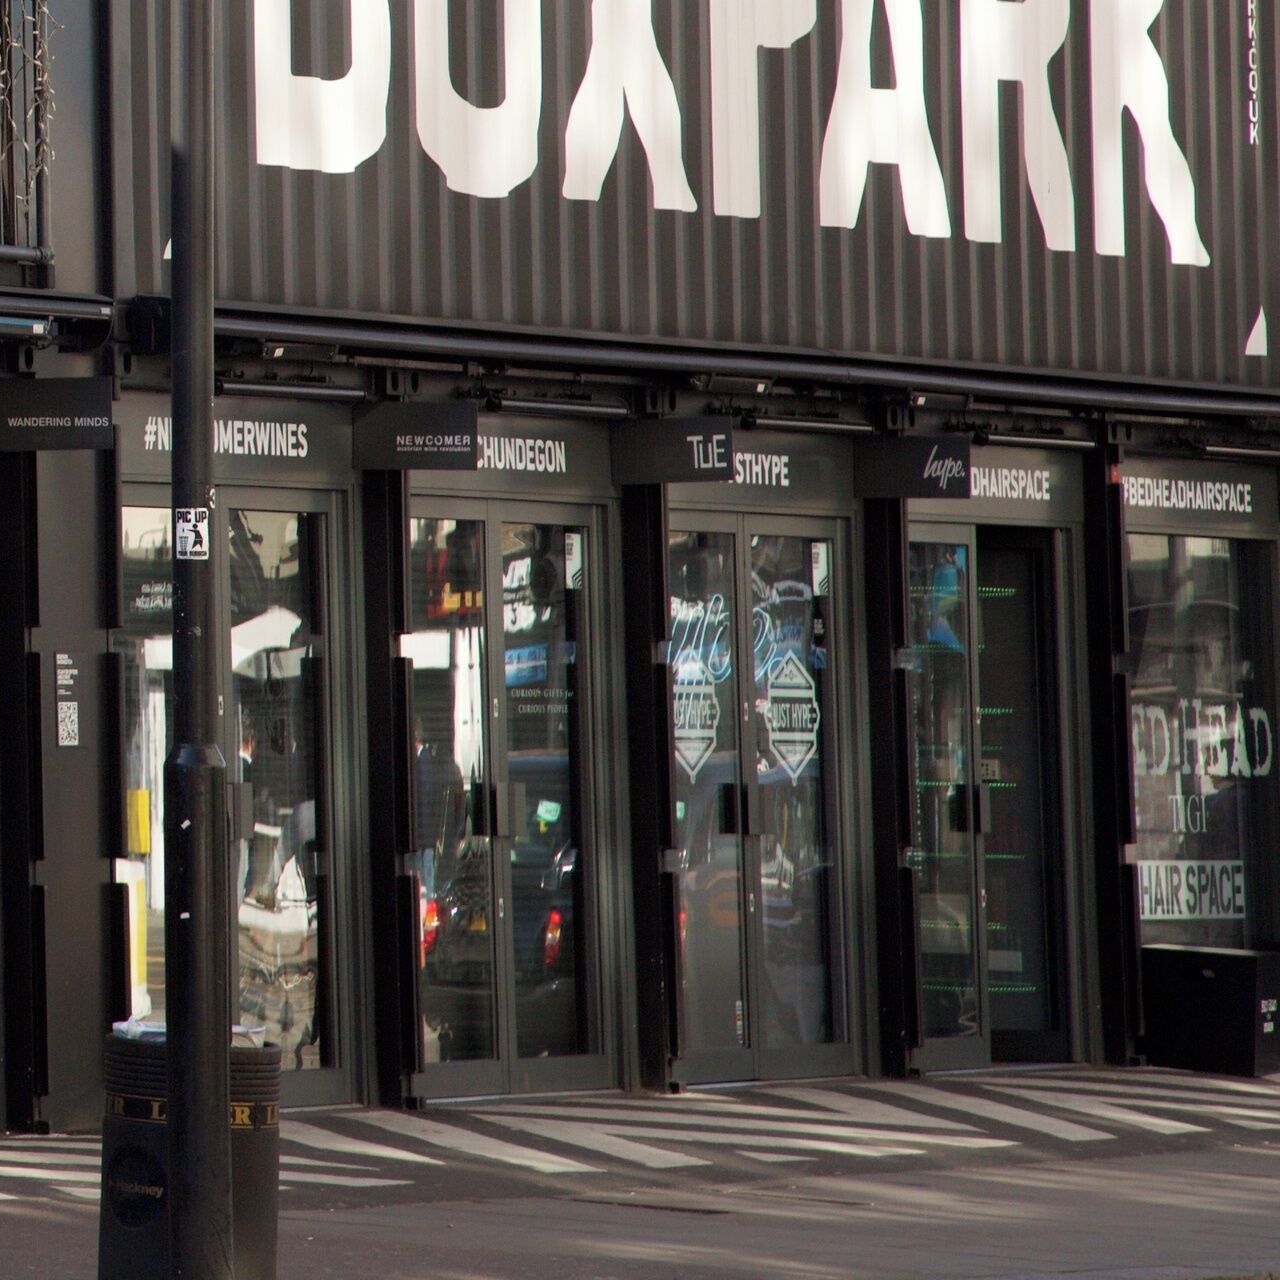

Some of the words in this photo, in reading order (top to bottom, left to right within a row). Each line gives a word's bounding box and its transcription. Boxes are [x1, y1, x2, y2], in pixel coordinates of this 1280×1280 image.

[7, 417, 72, 427] WANDERING
[74, 416, 110, 427] MINDS
[396, 435, 471, 446] NEWCOMER
[176, 510, 192, 523] PIC
[194, 510, 207, 523] UP
[543, 688, 563, 698] GIFTS
[518, 703, 545, 714] CURIOUS
[547, 704, 568, 714] PEOPLE
[791, 704, 812, 728] HYPE
[1177, 697, 1273, 779] HEAD
[1168, 793, 1208, 834] TIGI
[1140, 864, 1183, 916] HAIR
[1186, 865, 1244, 915] SPACE
